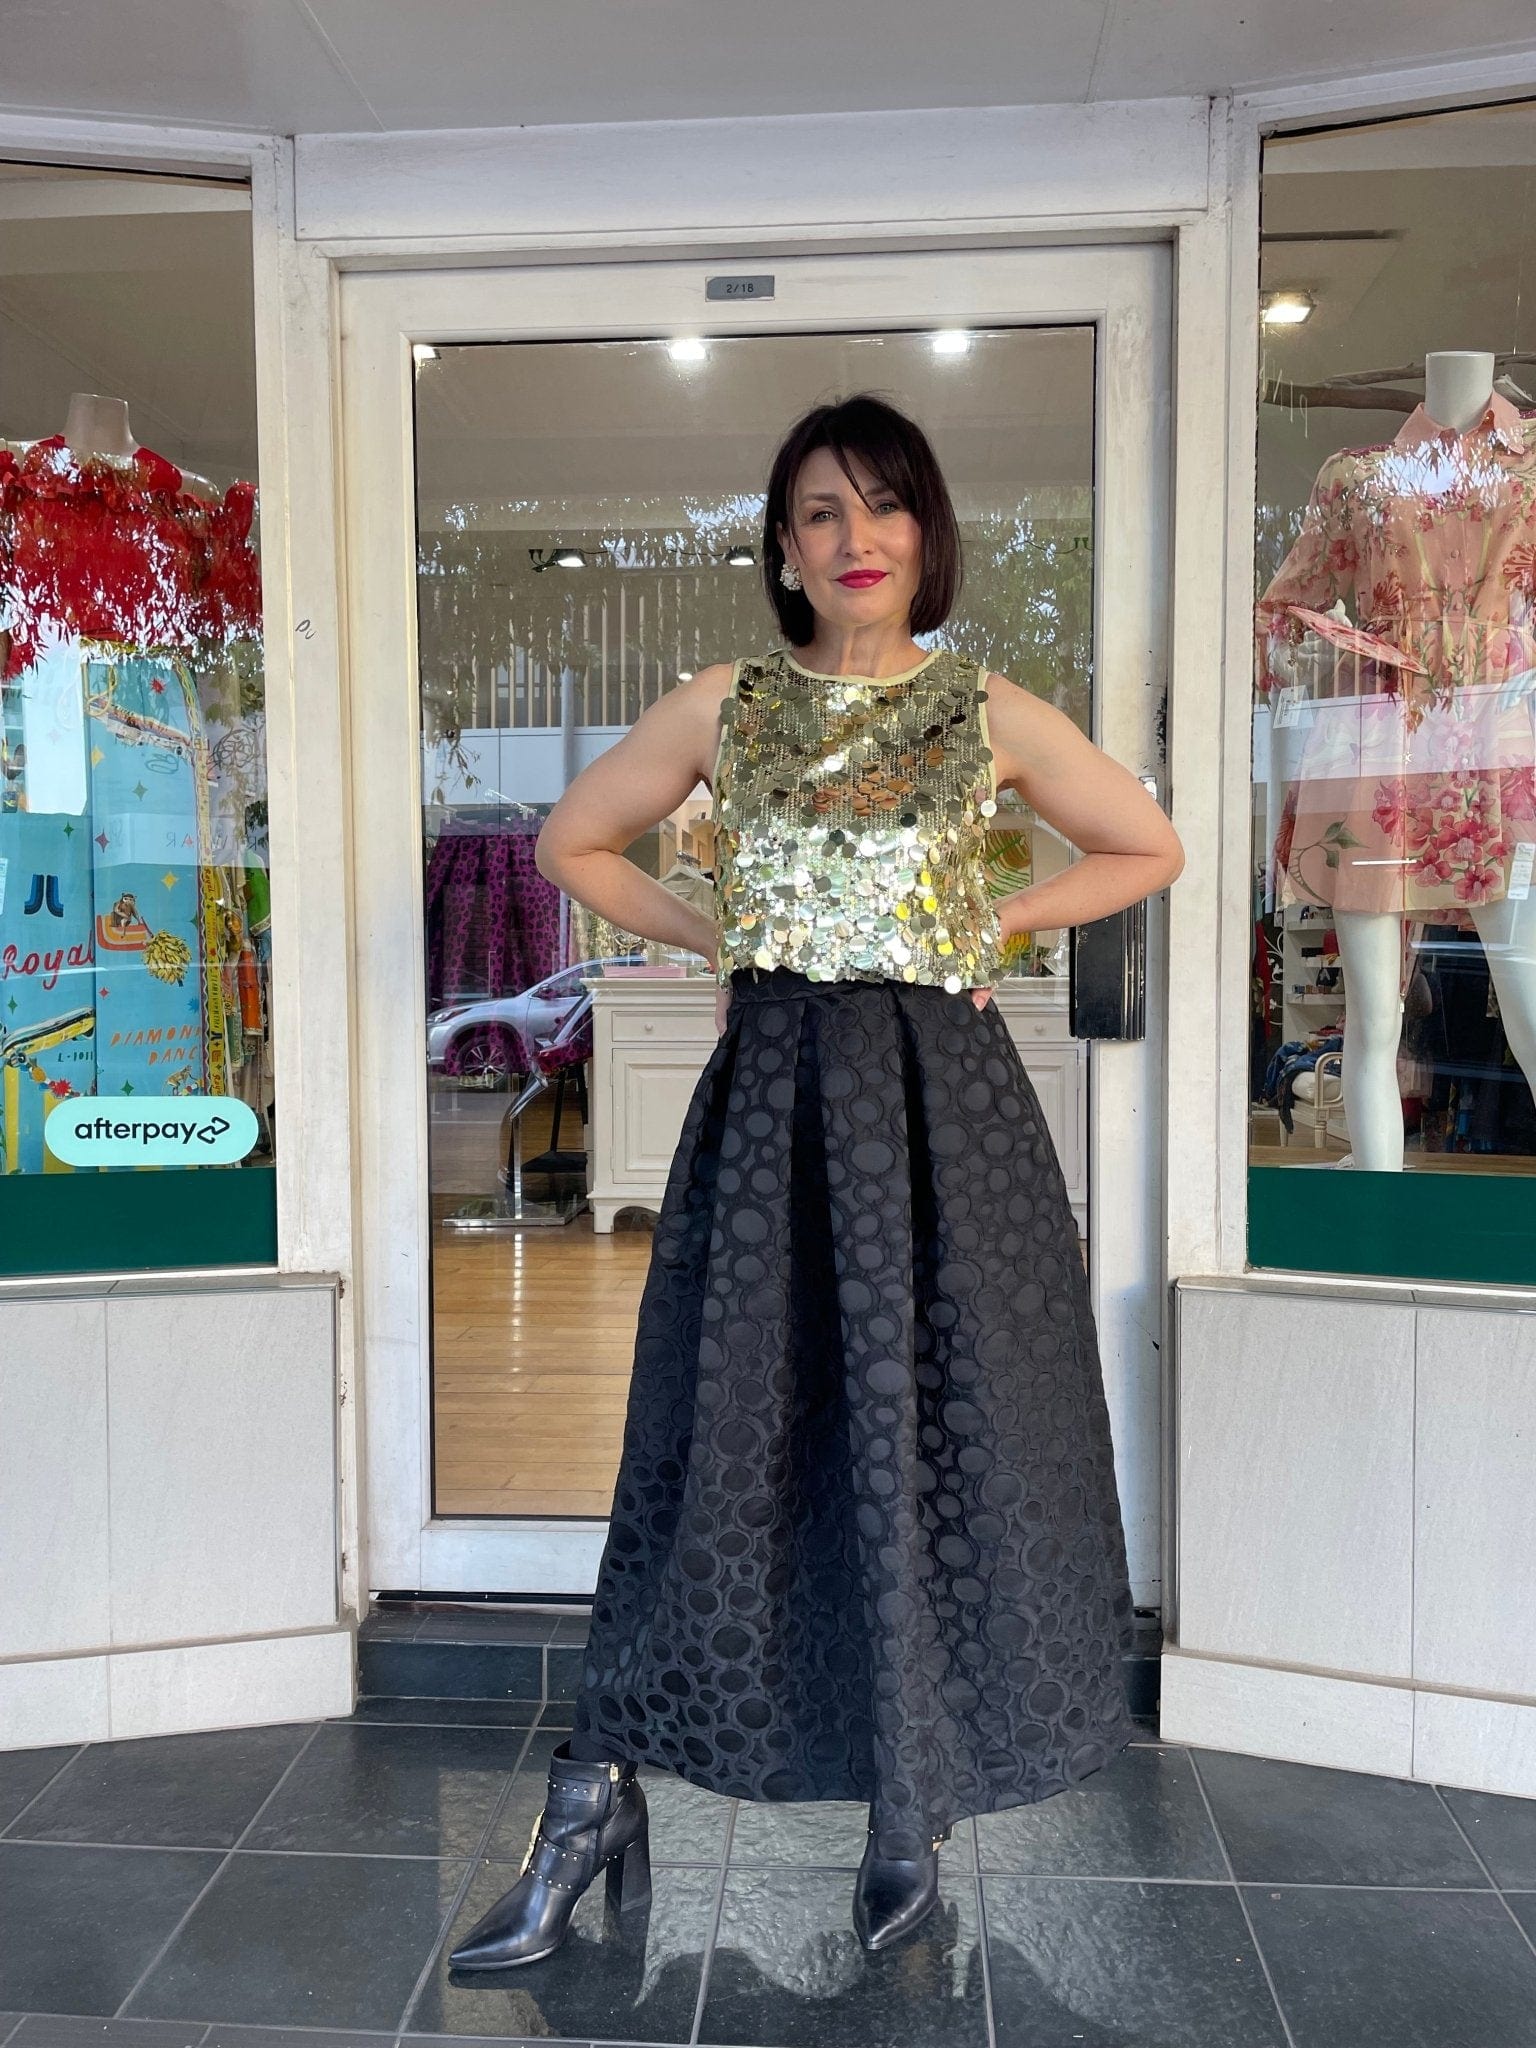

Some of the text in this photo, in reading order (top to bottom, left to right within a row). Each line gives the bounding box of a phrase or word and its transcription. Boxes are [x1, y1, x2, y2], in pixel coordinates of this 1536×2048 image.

[726, 284, 754, 294] 2/18
[2, 929, 95, 991] Royal
[74, 1117, 197, 1144] afterpay
